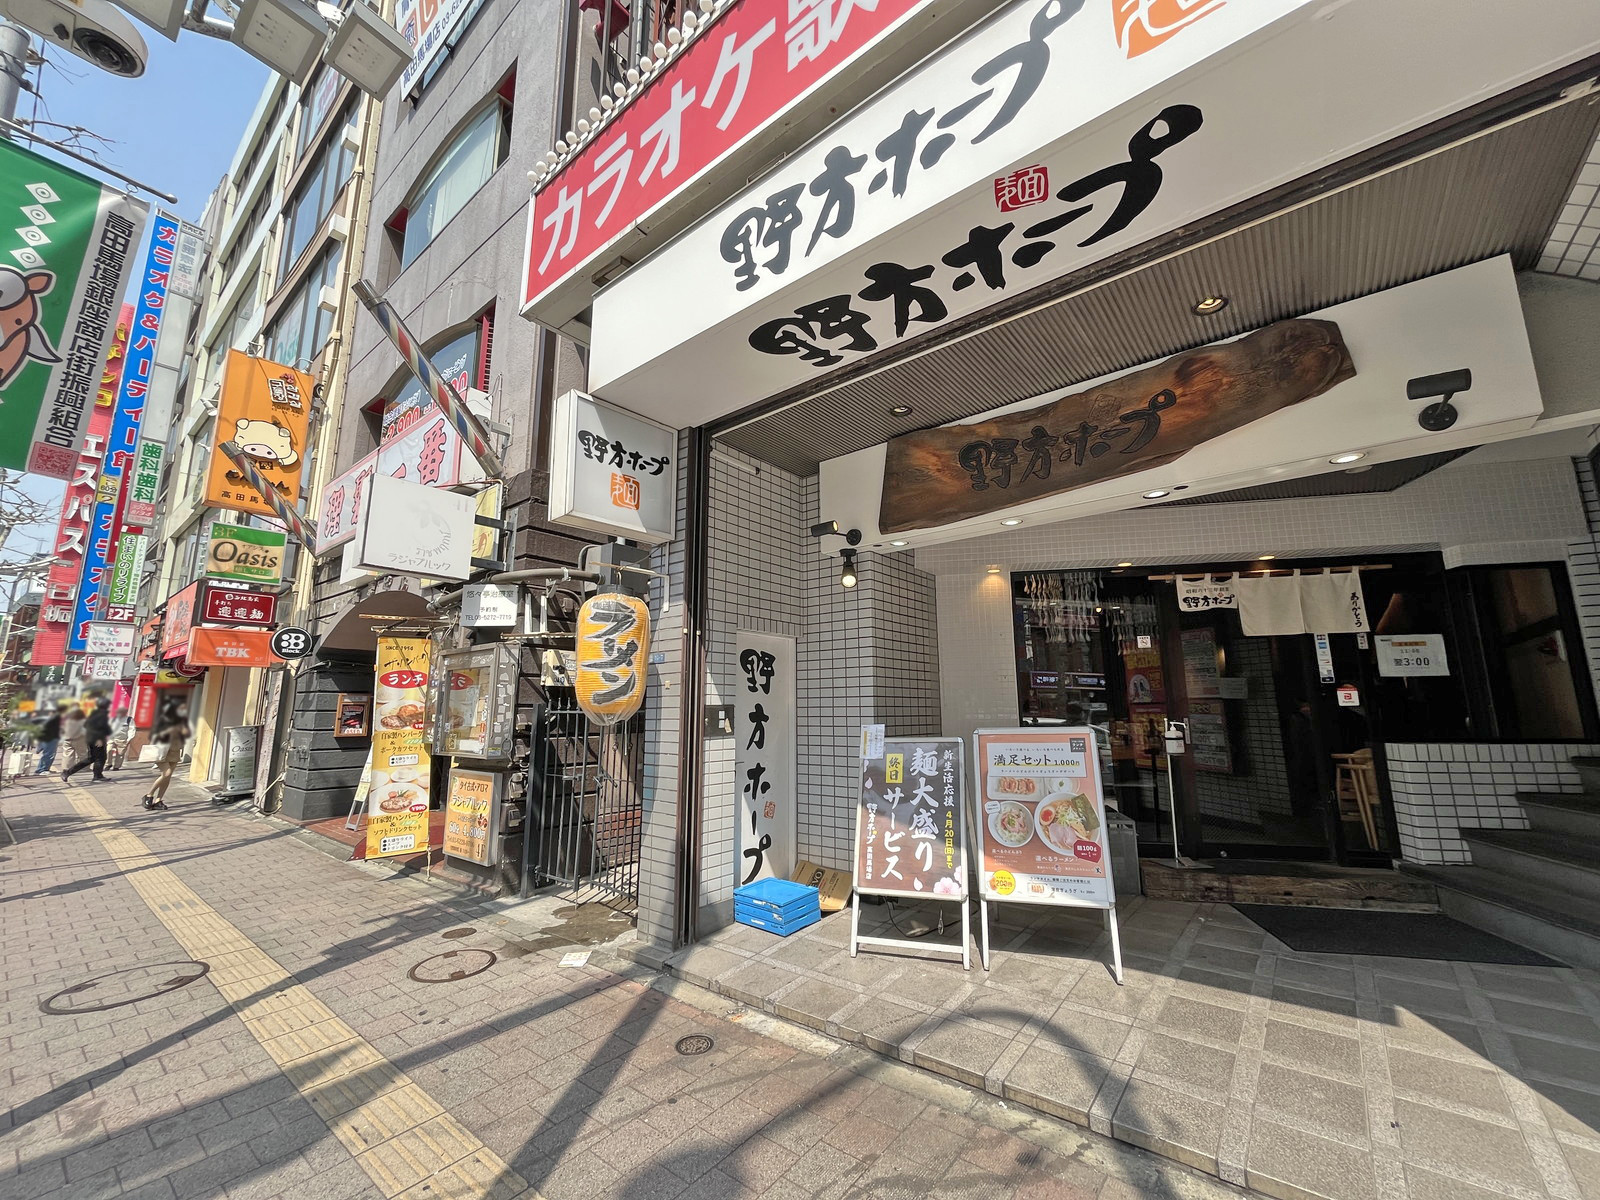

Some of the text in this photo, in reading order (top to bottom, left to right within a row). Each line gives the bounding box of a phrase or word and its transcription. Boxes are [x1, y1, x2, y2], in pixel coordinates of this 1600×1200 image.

[720, 0, 1088, 292] 野方ホープ
[748, 104, 1204, 367] 野方ホープ
[44, 210, 136, 449] 高田馬場銀座商店街振興組合
[578, 430, 670, 476] 野方ホープ
[957, 388, 1177, 492] 野方ホープ
[133, 443, 163, 503] 歯科歯科
[114, 535, 137, 602] 住まいのリライフ
[213, 541, 278, 568] Oasis
[113, 608, 134, 620] 2F
[1182, 593, 1235, 608] 野方ホープ
[1350, 592, 1362, 628] ありがとう
[215, 647, 250, 658] TBK
[389, 673, 424, 686] ランチ
[740, 648, 777, 886] 野方ホープ
[888, 757, 901, 781] 終日
[943, 750, 955, 807] 新生活応援
[993, 754, 1051, 766] 満足セット
[866, 803, 878, 845] 野方ホープ
[881, 786, 906, 881] サービス
[909, 747, 939, 872] 麺大盛り
